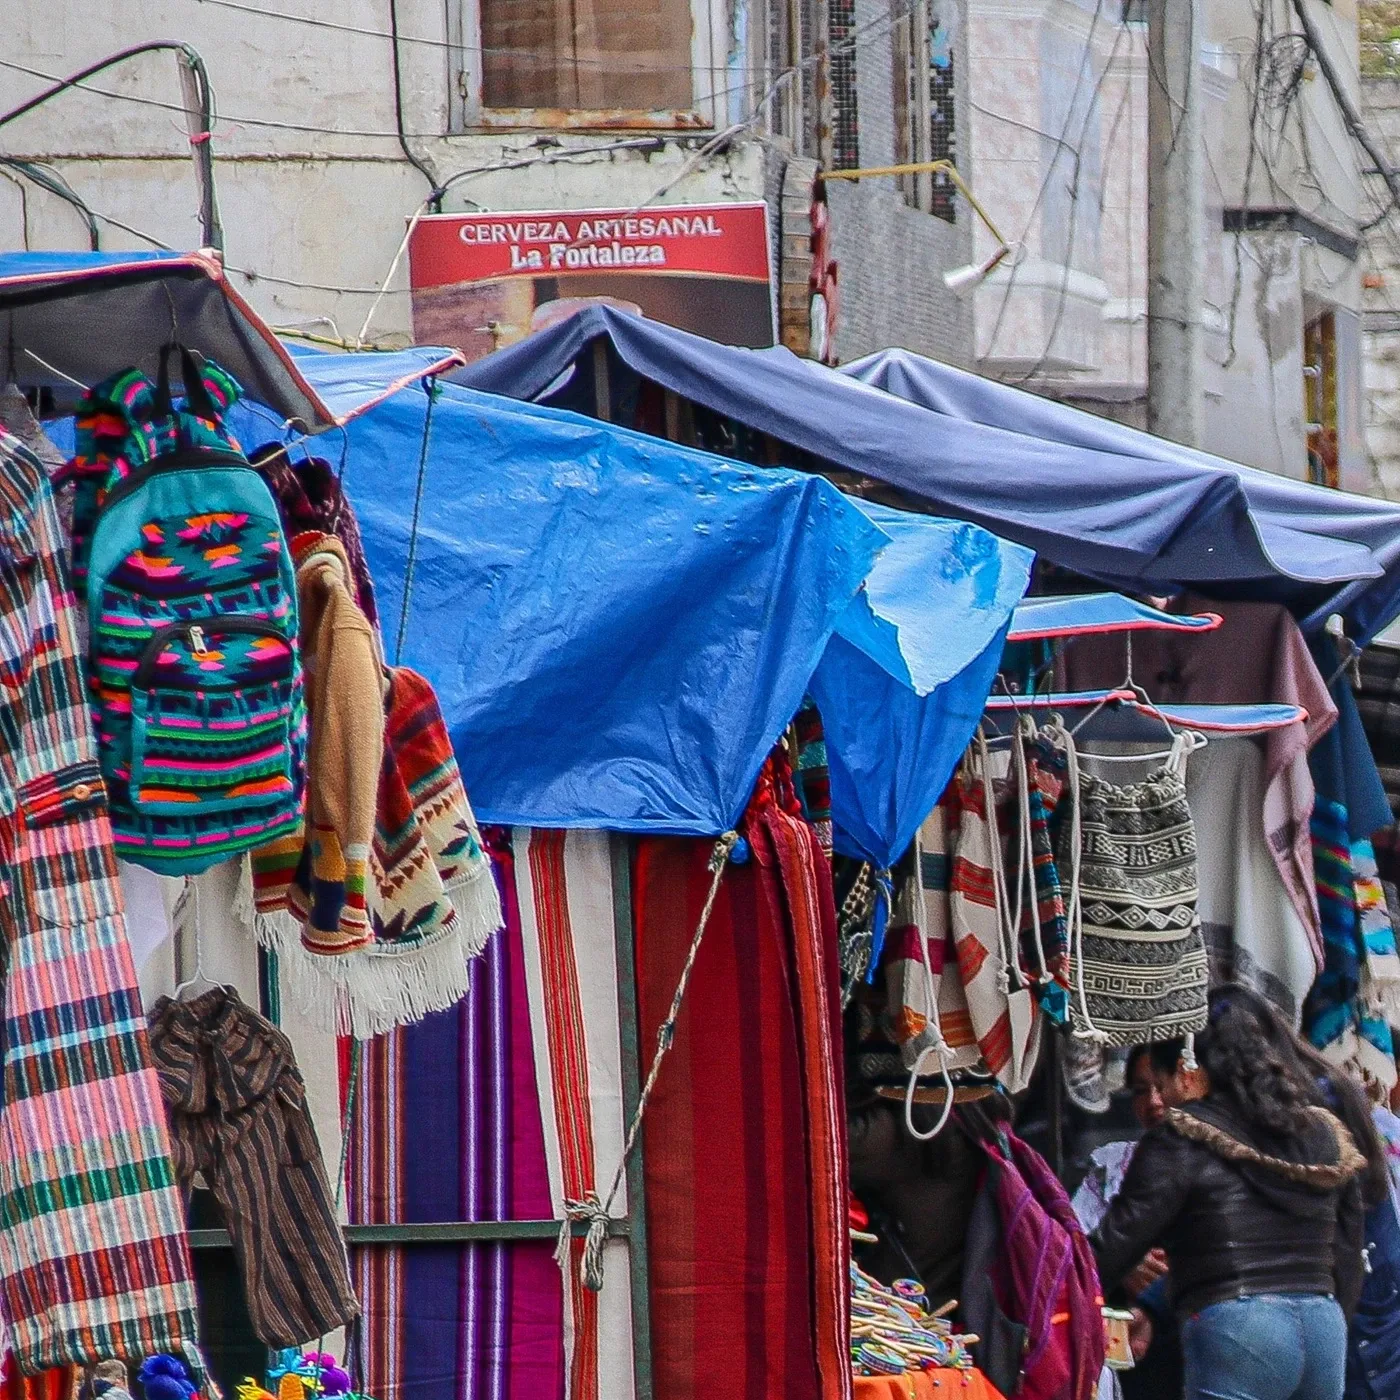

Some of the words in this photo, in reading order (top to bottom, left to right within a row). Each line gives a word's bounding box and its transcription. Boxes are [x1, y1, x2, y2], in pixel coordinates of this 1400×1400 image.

[459, 220, 571, 244] CERVEZA
[576, 215, 722, 242] ARTESANAL
[510, 243, 543, 269] La
[549, 241, 665, 268] Fortaleza
